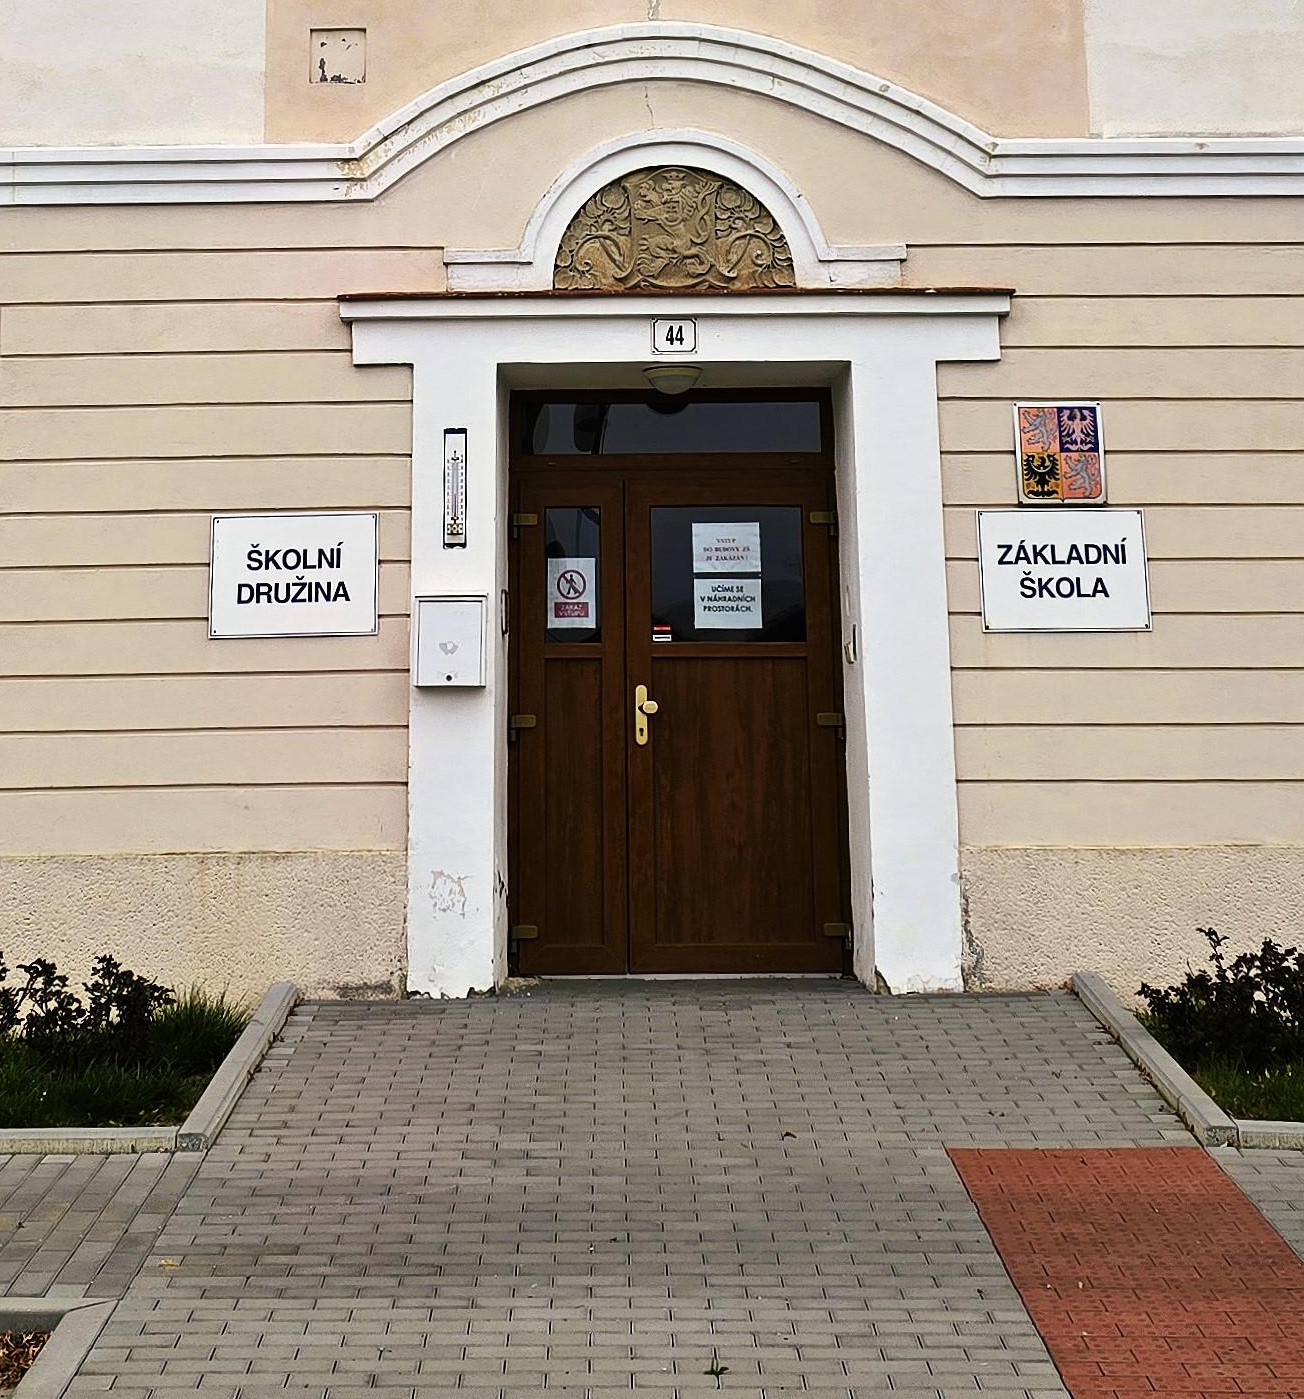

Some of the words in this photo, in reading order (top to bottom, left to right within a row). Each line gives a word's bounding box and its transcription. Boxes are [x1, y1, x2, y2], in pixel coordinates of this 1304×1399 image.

[666, 325, 684, 345] 44
[247, 542, 344, 571] ŠKOLNÍ
[997, 537, 1127, 565] ZÁKLADNÍ
[237, 576, 351, 604] DRUŽINA
[1020, 571, 1110, 599] ŠKOLA
